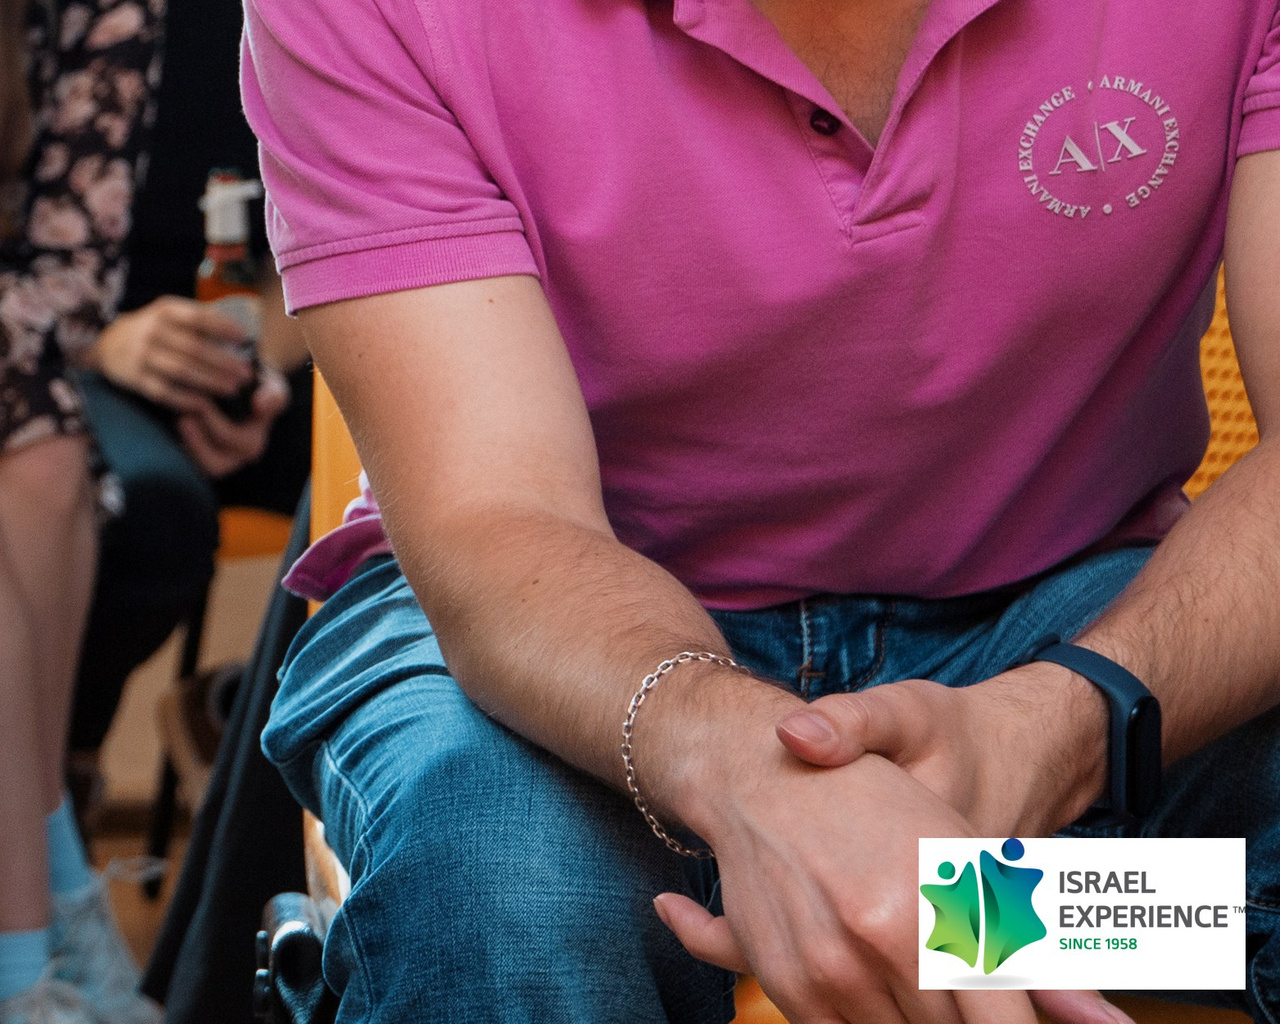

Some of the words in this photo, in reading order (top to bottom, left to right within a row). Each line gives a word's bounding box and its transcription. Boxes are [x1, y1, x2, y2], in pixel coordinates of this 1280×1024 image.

[1099, 74, 1170, 116] ARMANI
[1018, 86, 1076, 171] EXCHANGE
[1125, 117, 1180, 208] EXCHANGE
[1023, 174, 1091, 219] ARMANI
